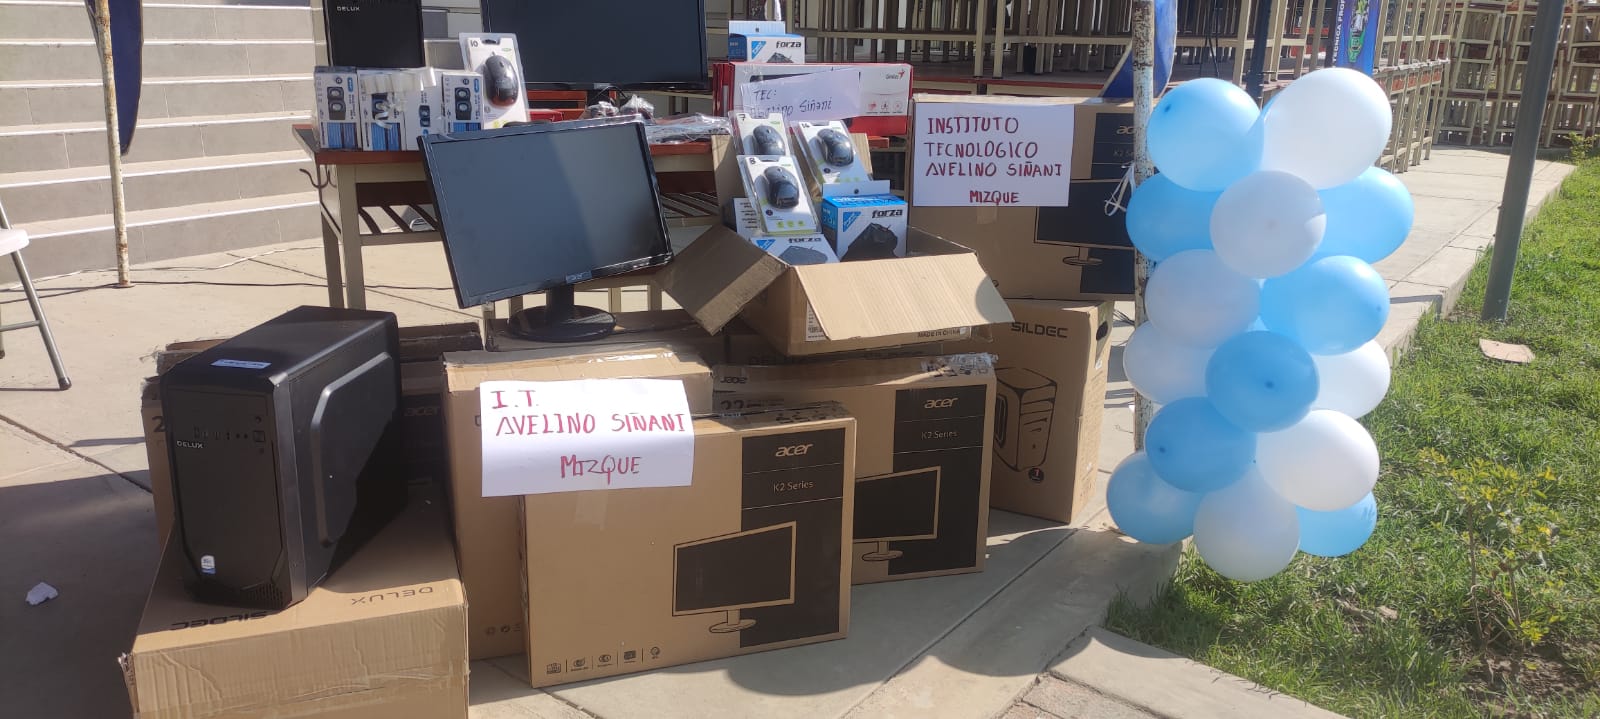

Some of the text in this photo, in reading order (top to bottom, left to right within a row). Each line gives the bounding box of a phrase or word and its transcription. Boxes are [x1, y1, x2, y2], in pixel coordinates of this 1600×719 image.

[776, 40, 802, 49] forza
[927, 117, 1019, 135] INSTITUTO
[1116, 125, 1137, 135] ac
[924, 140, 1038, 158] TECNOLOGICO
[925, 161, 1062, 177] AVELINO SIÑANI
[969, 190, 1020, 206] MIZQUE
[871, 208, 903, 219] forza
[1011, 321, 1069, 339] SILDEC
[924, 397, 959, 409] acer
[495, 413, 596, 437] AVELINO
[921, 430, 958, 440] K2 Series
[176, 440, 204, 449] DELUX
[775, 443, 814, 457] acer
[560, 453, 643, 486] MIZQUE
[773, 479, 814, 494] K2 Series
[351, 586, 435, 605] DELUX
[170, 611, 268, 631] SILDEC
